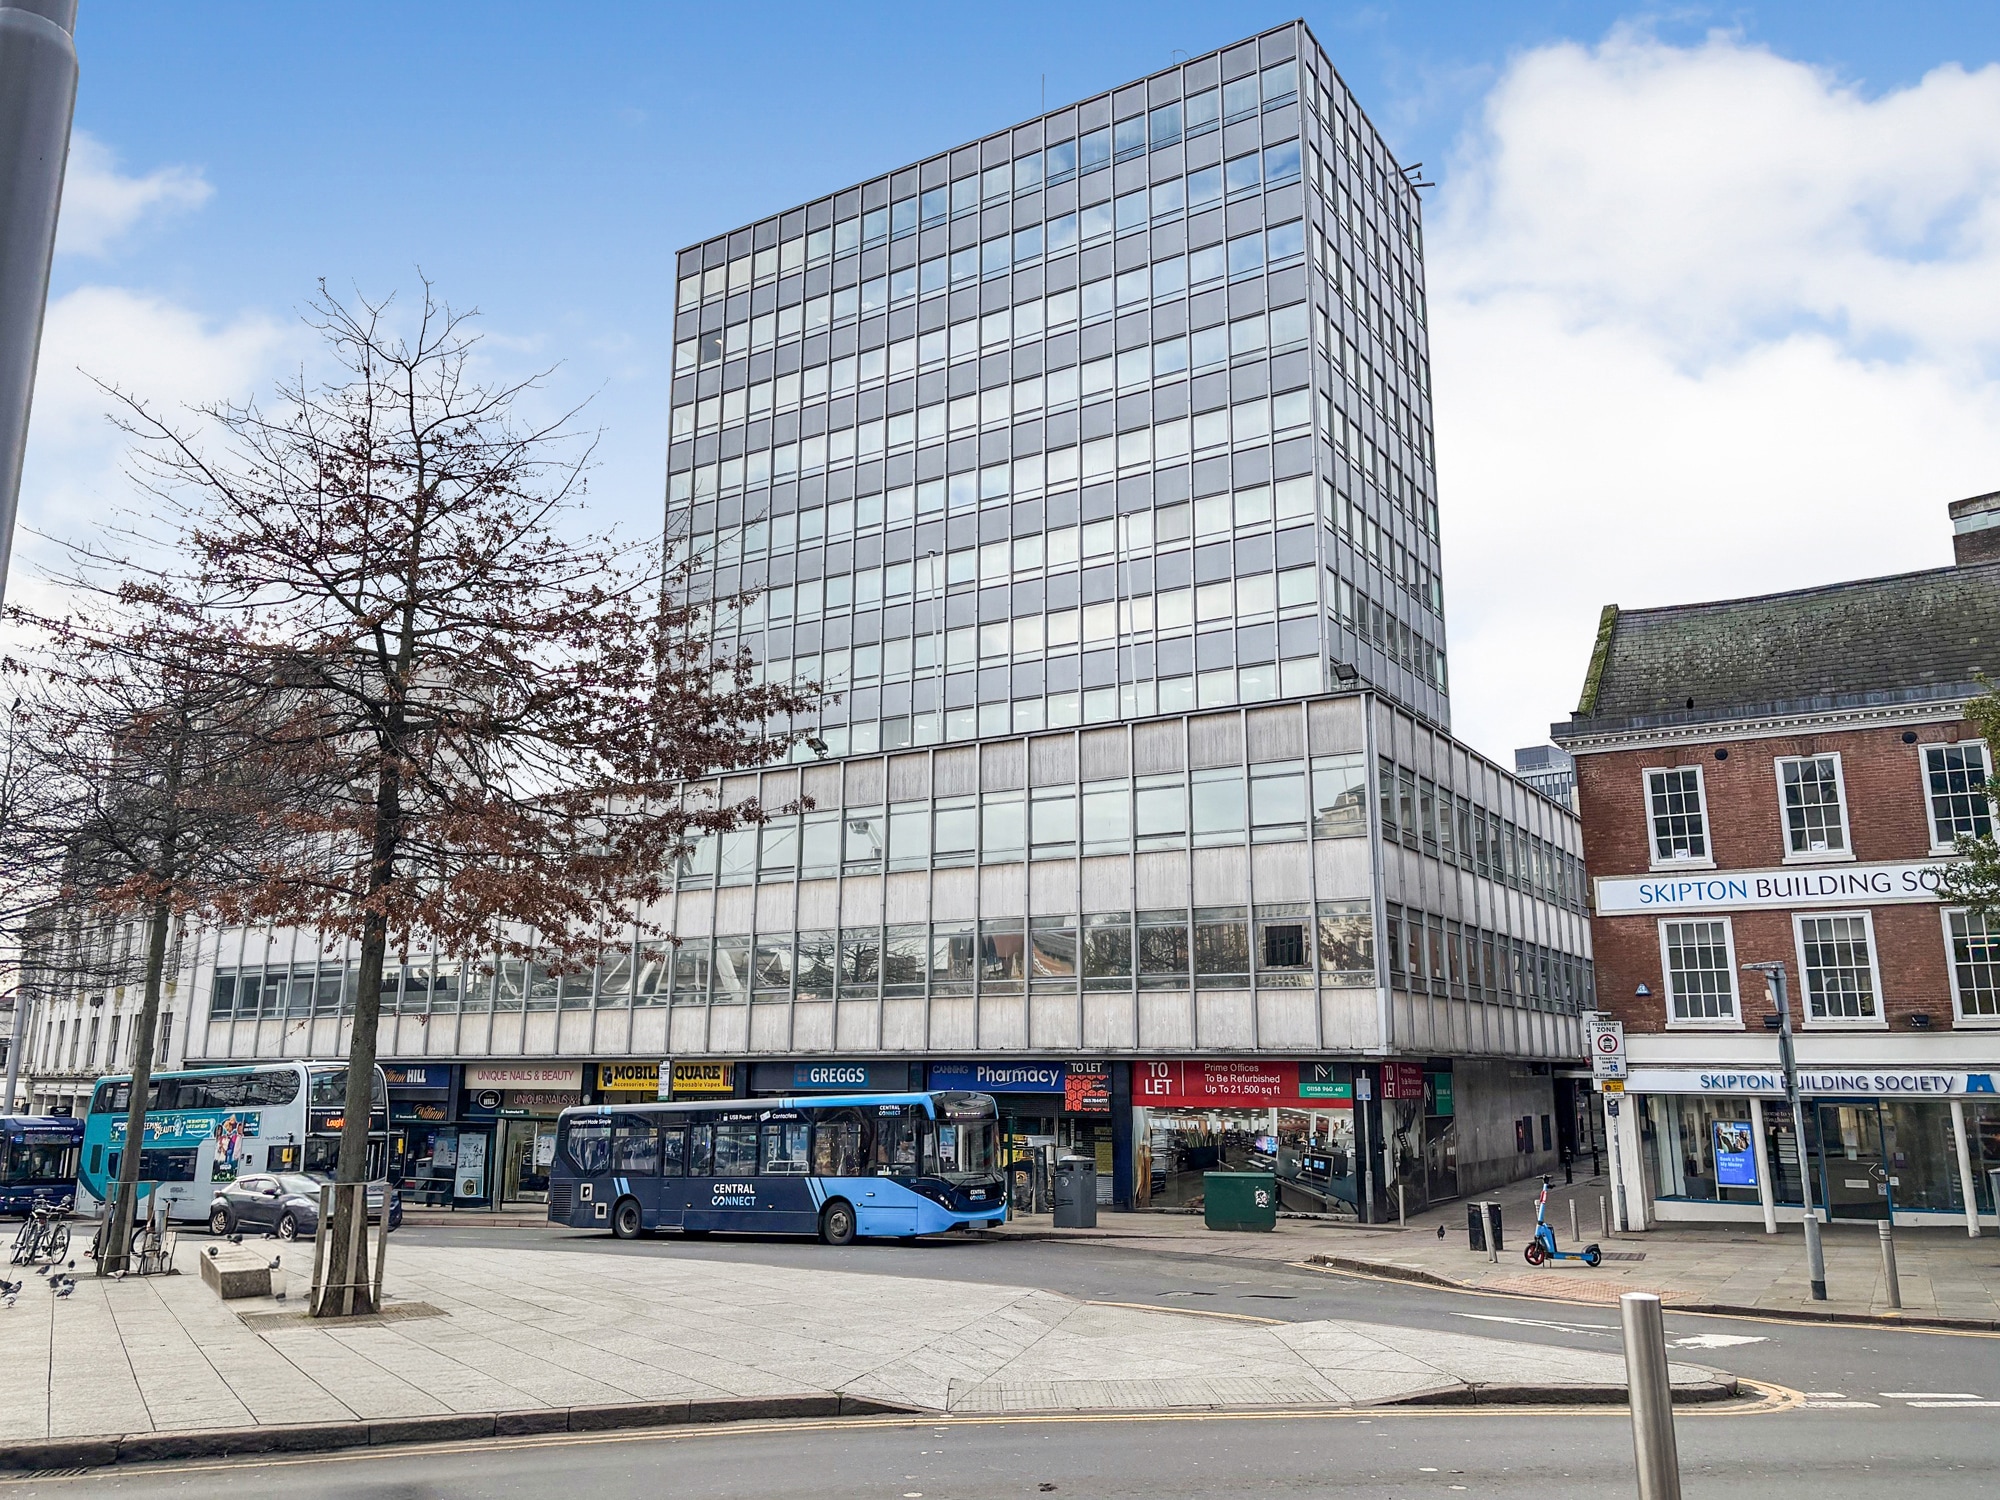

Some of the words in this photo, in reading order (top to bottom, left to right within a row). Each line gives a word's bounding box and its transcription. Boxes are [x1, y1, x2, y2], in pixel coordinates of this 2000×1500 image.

[1639, 879, 1747, 904] SKIPTON
[1756, 872, 1892, 898] BUILDING
[674, 1065, 721, 1081] QUARE
[810, 1067, 865, 1083] GREGGS
[932, 1065, 969, 1074] CANNING
[1070, 1062, 1084, 1073] TO
[1086, 1062, 1102, 1073] LET
[1147, 1062, 1169, 1078] TO
[1204, 1063, 1228, 1072] Prime
[1229, 1063, 1259, 1072] Offices
[1384, 1065, 1394, 1081] TO
[406, 1069, 427, 1083] HILL
[477, 1070, 508, 1082] UNIQUE
[509, 1070, 532, 1081] NAILS
[534, 1071, 540, 1081] &
[541, 1070, 575, 1081] BEAUTY
[976, 1066, 1060, 1087] Pharmacy
[1204, 1073, 1215, 1082] To
[1216, 1074, 1228, 1082] Be
[1230, 1074, 1280, 1083] Refurbished
[1144, 1079, 1173, 1095] LET
[1205, 1085, 1217, 1095] Up
[1219, 1085, 1229, 1094] To
[1230, 1085, 1260, 1095] 21,500
[1261, 1086, 1272, 1096] sq
[1273, 1085, 1281, 1094] ft
[1383, 1082, 1396, 1098] LET
[1700, 1074, 1774, 1089] SKIPTON
[1874, 1075, 1954, 1094] SOCIETY
[713, 1183, 755, 1194] CENTRAL
[711, 1195, 757, 1206] CONNECT
